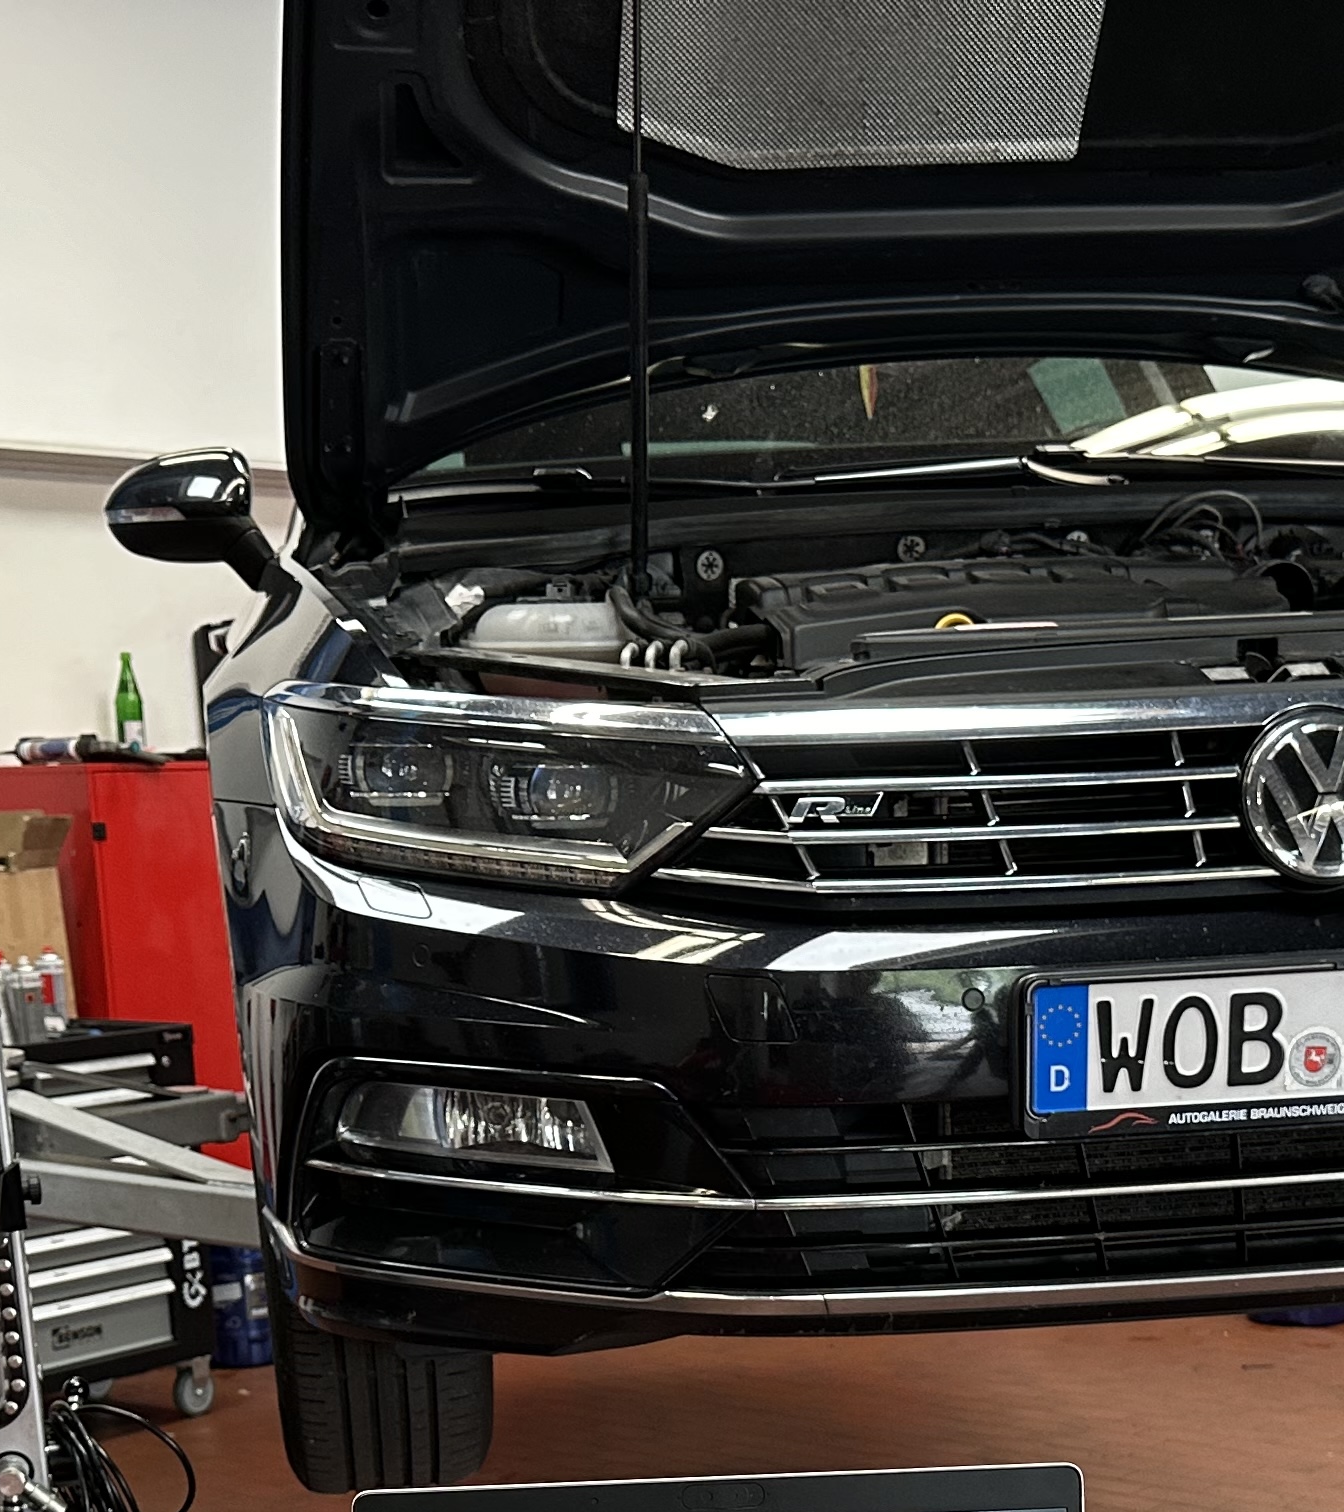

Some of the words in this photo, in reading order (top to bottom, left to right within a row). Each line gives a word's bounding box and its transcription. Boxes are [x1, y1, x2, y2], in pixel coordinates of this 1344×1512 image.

[1096, 991, 1286, 1093] WOB
[1049, 1064, 1072, 1093] D
[1168, 1107, 1248, 1125] AUTOGALERIE
